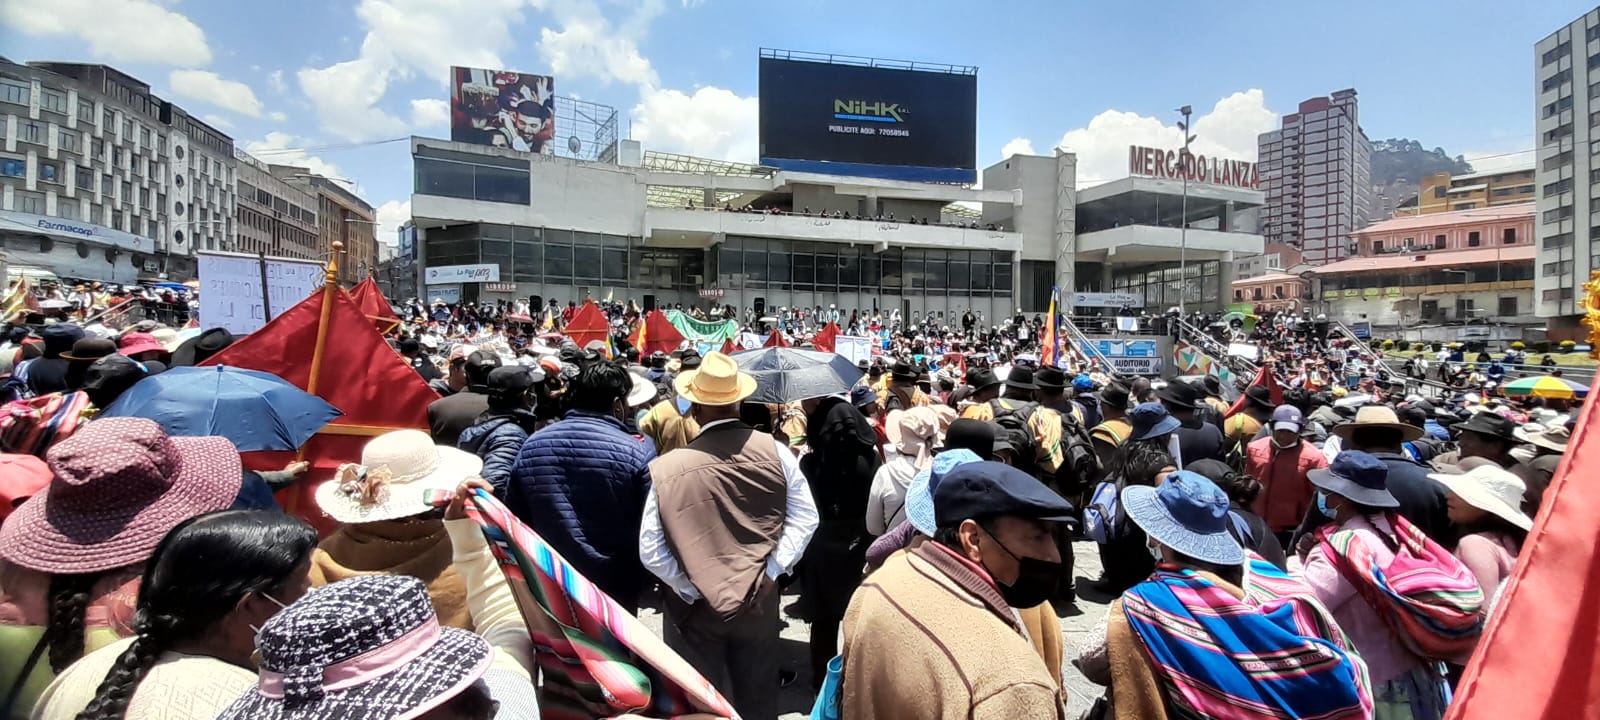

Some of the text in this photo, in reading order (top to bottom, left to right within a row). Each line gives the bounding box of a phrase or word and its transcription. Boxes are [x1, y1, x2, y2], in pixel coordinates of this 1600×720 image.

[834, 99, 904, 122] NiHK
[828, 125, 859, 134] PUBLICITE
[1129, 145, 1260, 188] MERCADO LANZA
[37, 219, 93, 237] Farmacorp
[1115, 359, 1150, 368] AUDITORIO
